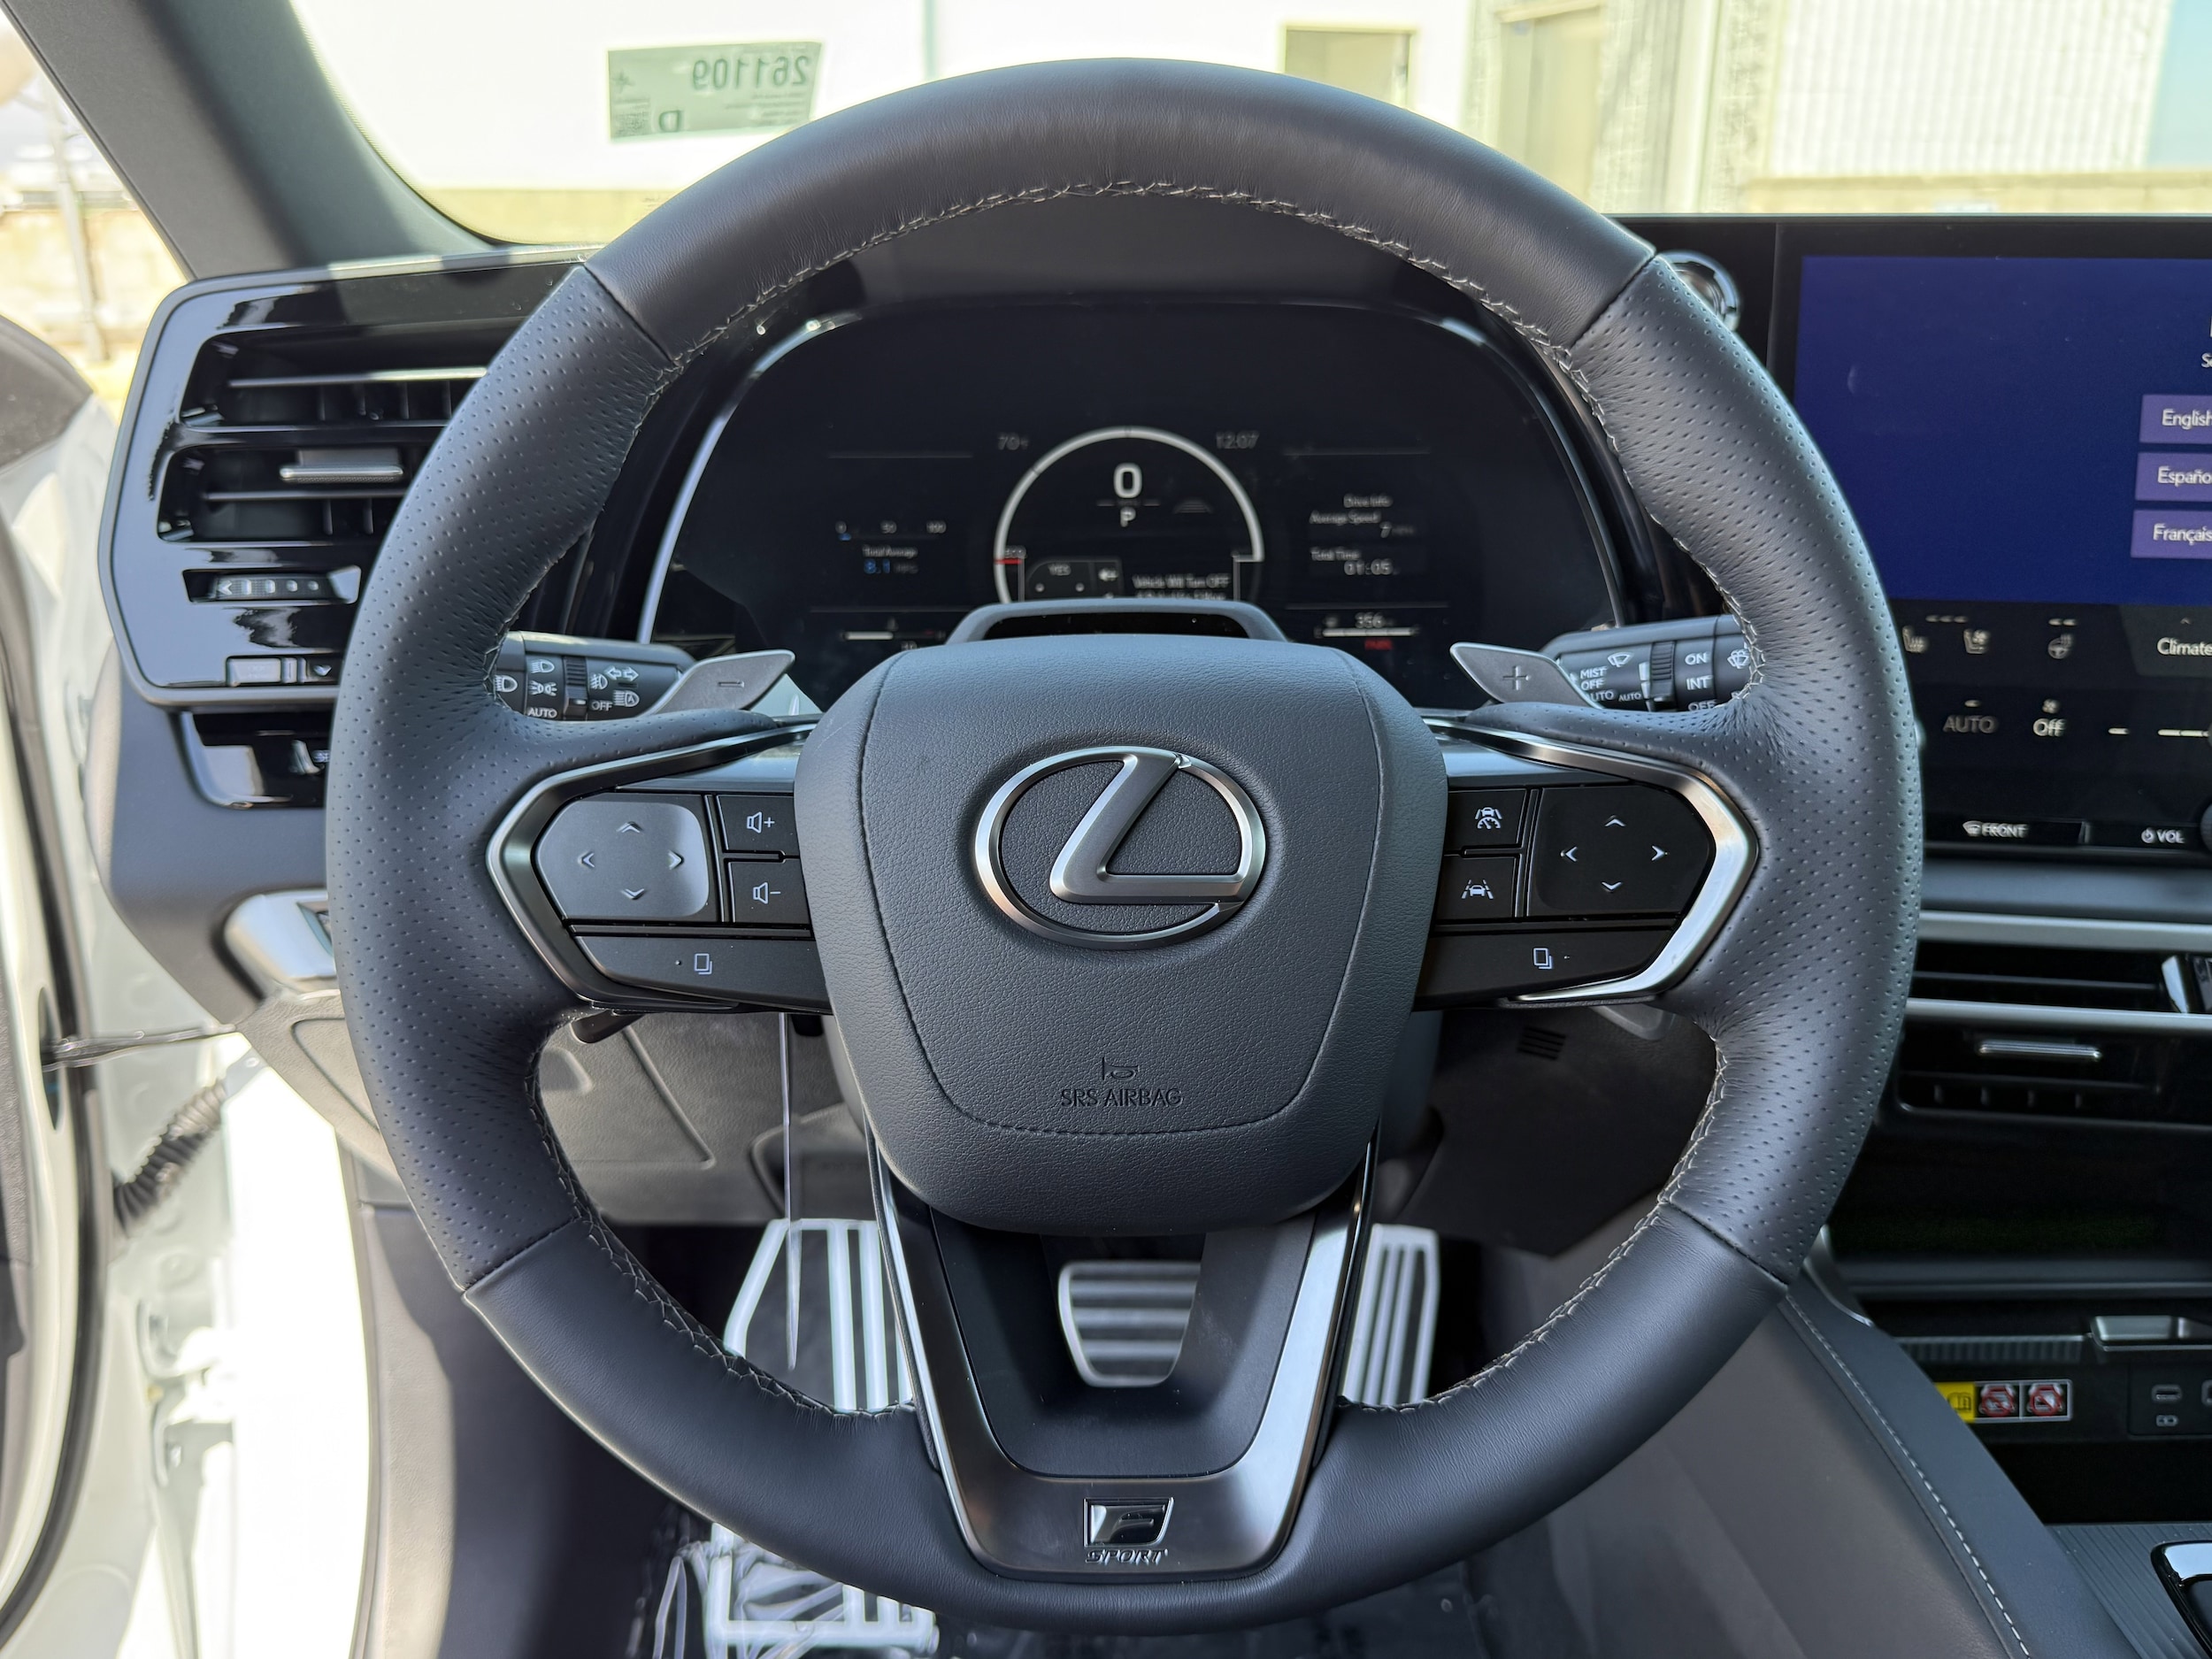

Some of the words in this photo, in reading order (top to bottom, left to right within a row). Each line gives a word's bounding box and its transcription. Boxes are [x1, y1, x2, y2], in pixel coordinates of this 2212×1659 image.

[1113, 463, 1143, 499] 0
[2157, 465, 2212, 487] Españo
[1119, 506, 1137, 528] P
[2157, 636, 2212, 657] Climate
[1685, 652, 1708, 665] ON
[1579, 666, 1607, 680] MIST
[1580, 678, 1605, 691] OFF
[1686, 675, 1713, 690] INT
[591, 699, 613, 711] OFF
[1617, 692, 1642, 702] AUTO
[528, 707, 558, 718] AUTO
[1942, 714, 1999, 734] AUTO
[2032, 718, 2067, 737] Off
[1982, 822, 2029, 838] FRONT
[2156, 829, 2185, 844] VOL
[1061, 1088, 1100, 1107] SRS
[1105, 1088, 1184, 1107] AIRBAG
[1085, 1549, 1163, 1565] SPORT
